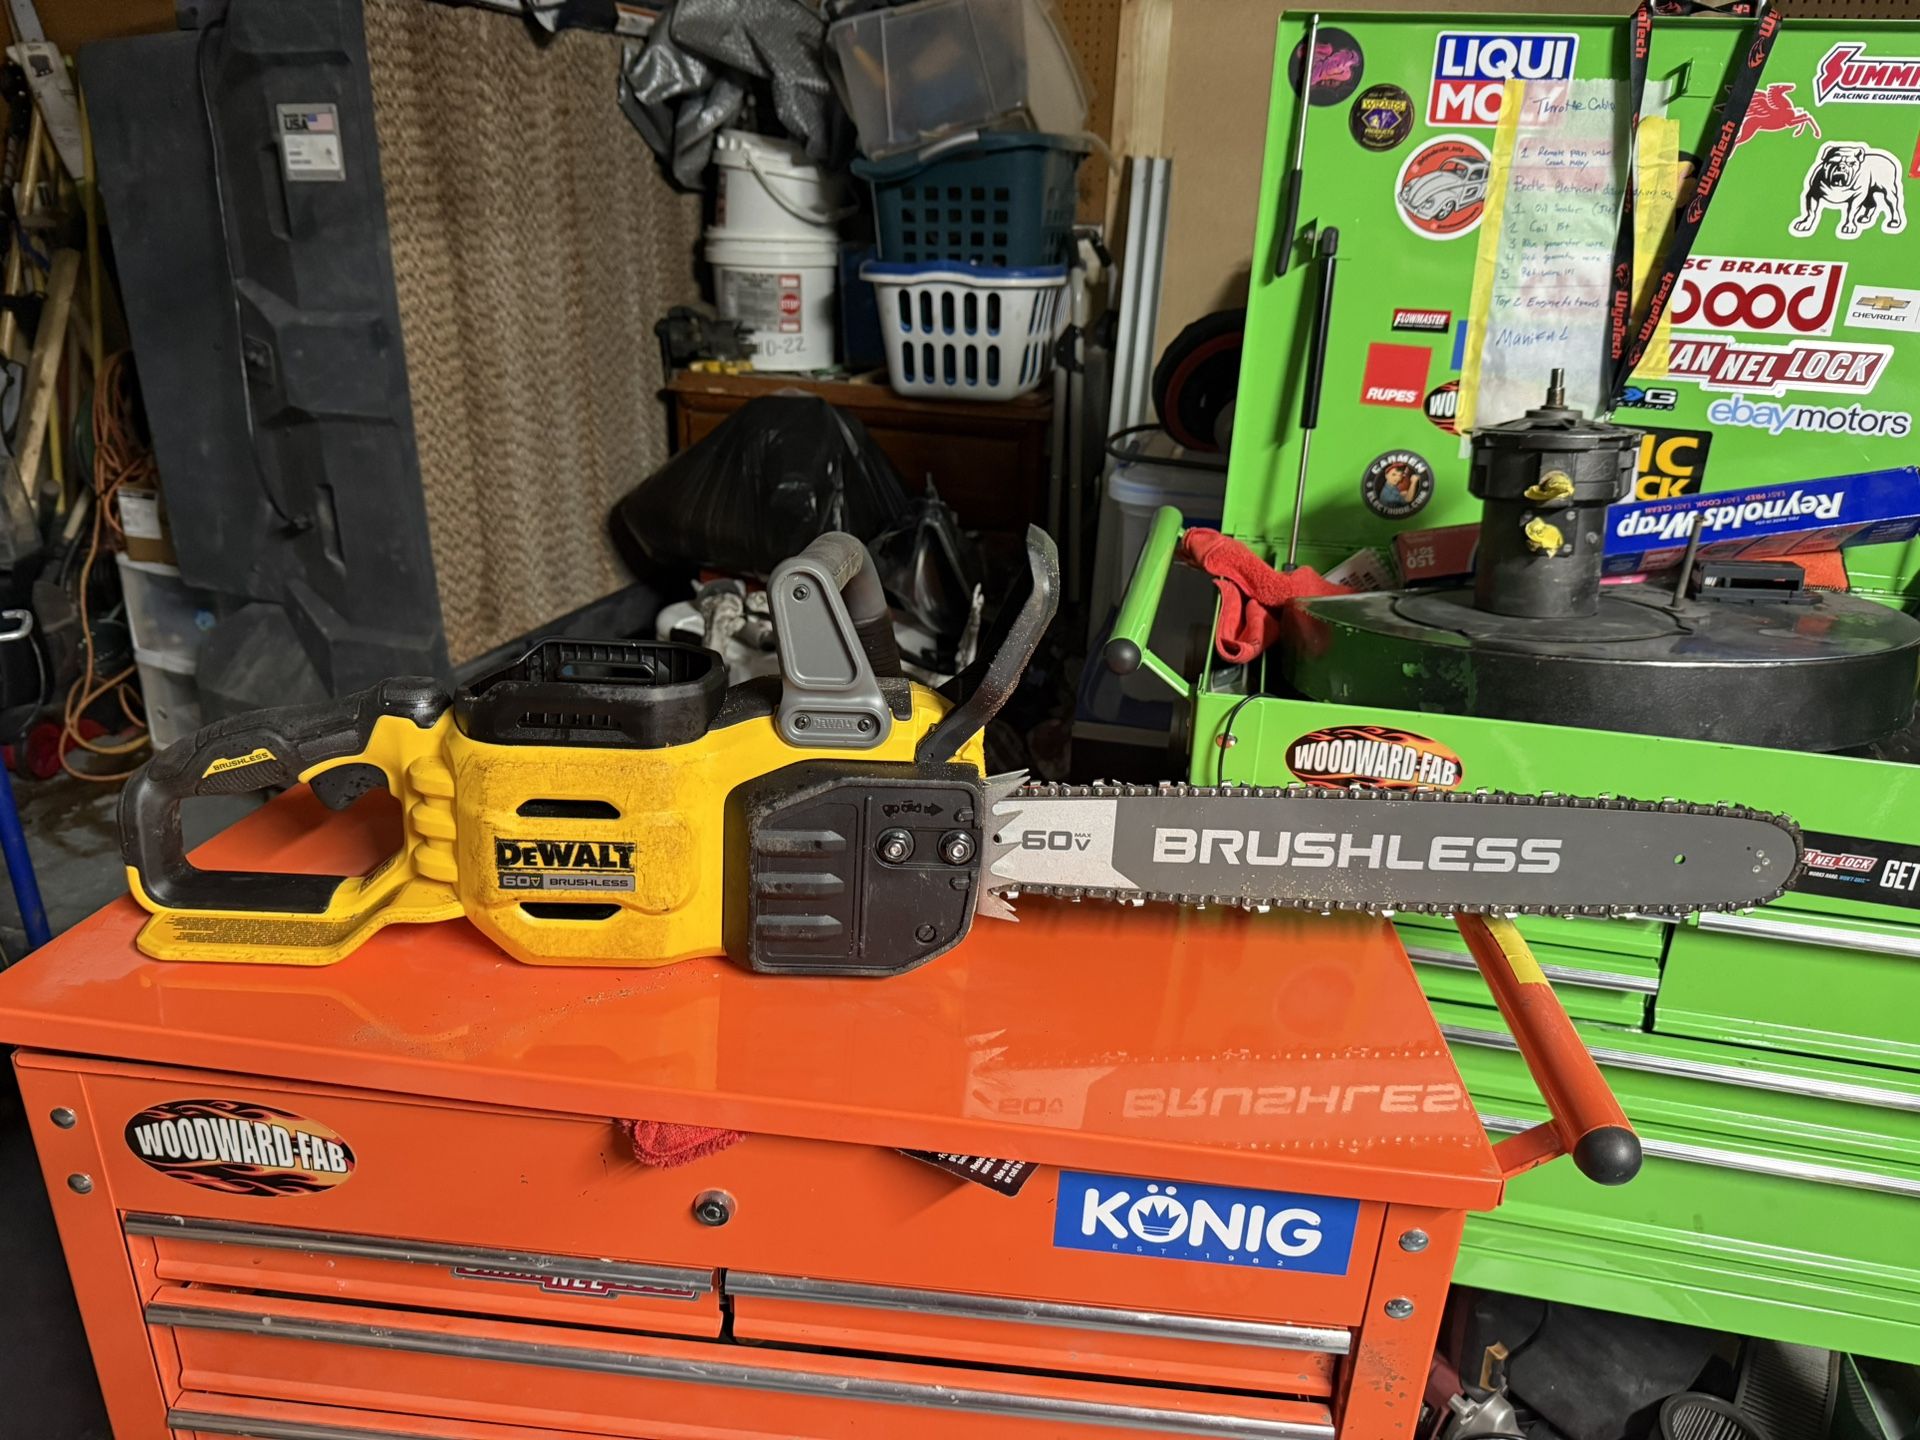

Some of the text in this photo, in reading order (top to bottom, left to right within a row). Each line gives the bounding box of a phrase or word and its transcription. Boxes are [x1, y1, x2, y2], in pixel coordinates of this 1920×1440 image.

[1442, 38, 1569, 79] LIQUI
[1833, 92, 1869, 101] RACING
[1696, 119, 1736, 195] WyoTech
[1719, 259, 1825, 276] BRAKES
[1639, 271, 1675, 341] WyoTech
[1852, 311, 1907, 322] CHEVROLET
[1393, 311, 1449, 327] FLOWMASTER
[1611, 290, 1628, 360] WyoTech
[1366, 387, 1419, 404] RUPES
[1371, 453, 1428, 475] CARMEN
[1746, 492, 1767, 501] PREP
[1616, 490, 1844, 540] Reynolds Wrap
[1406, 554, 1436, 569] 150
[212, 752, 269, 771] BRUSHLESS
[1294, 739, 1457, 786] WOODWARD-FAB
[1152, 827, 1563, 874] BRUSHLESS
[550, 878, 629, 887] BRUSHLESS
[134, 1117, 348, 1173] WOODWARD-FAB
[1081, 1184, 1322, 1257] KÖNIG
